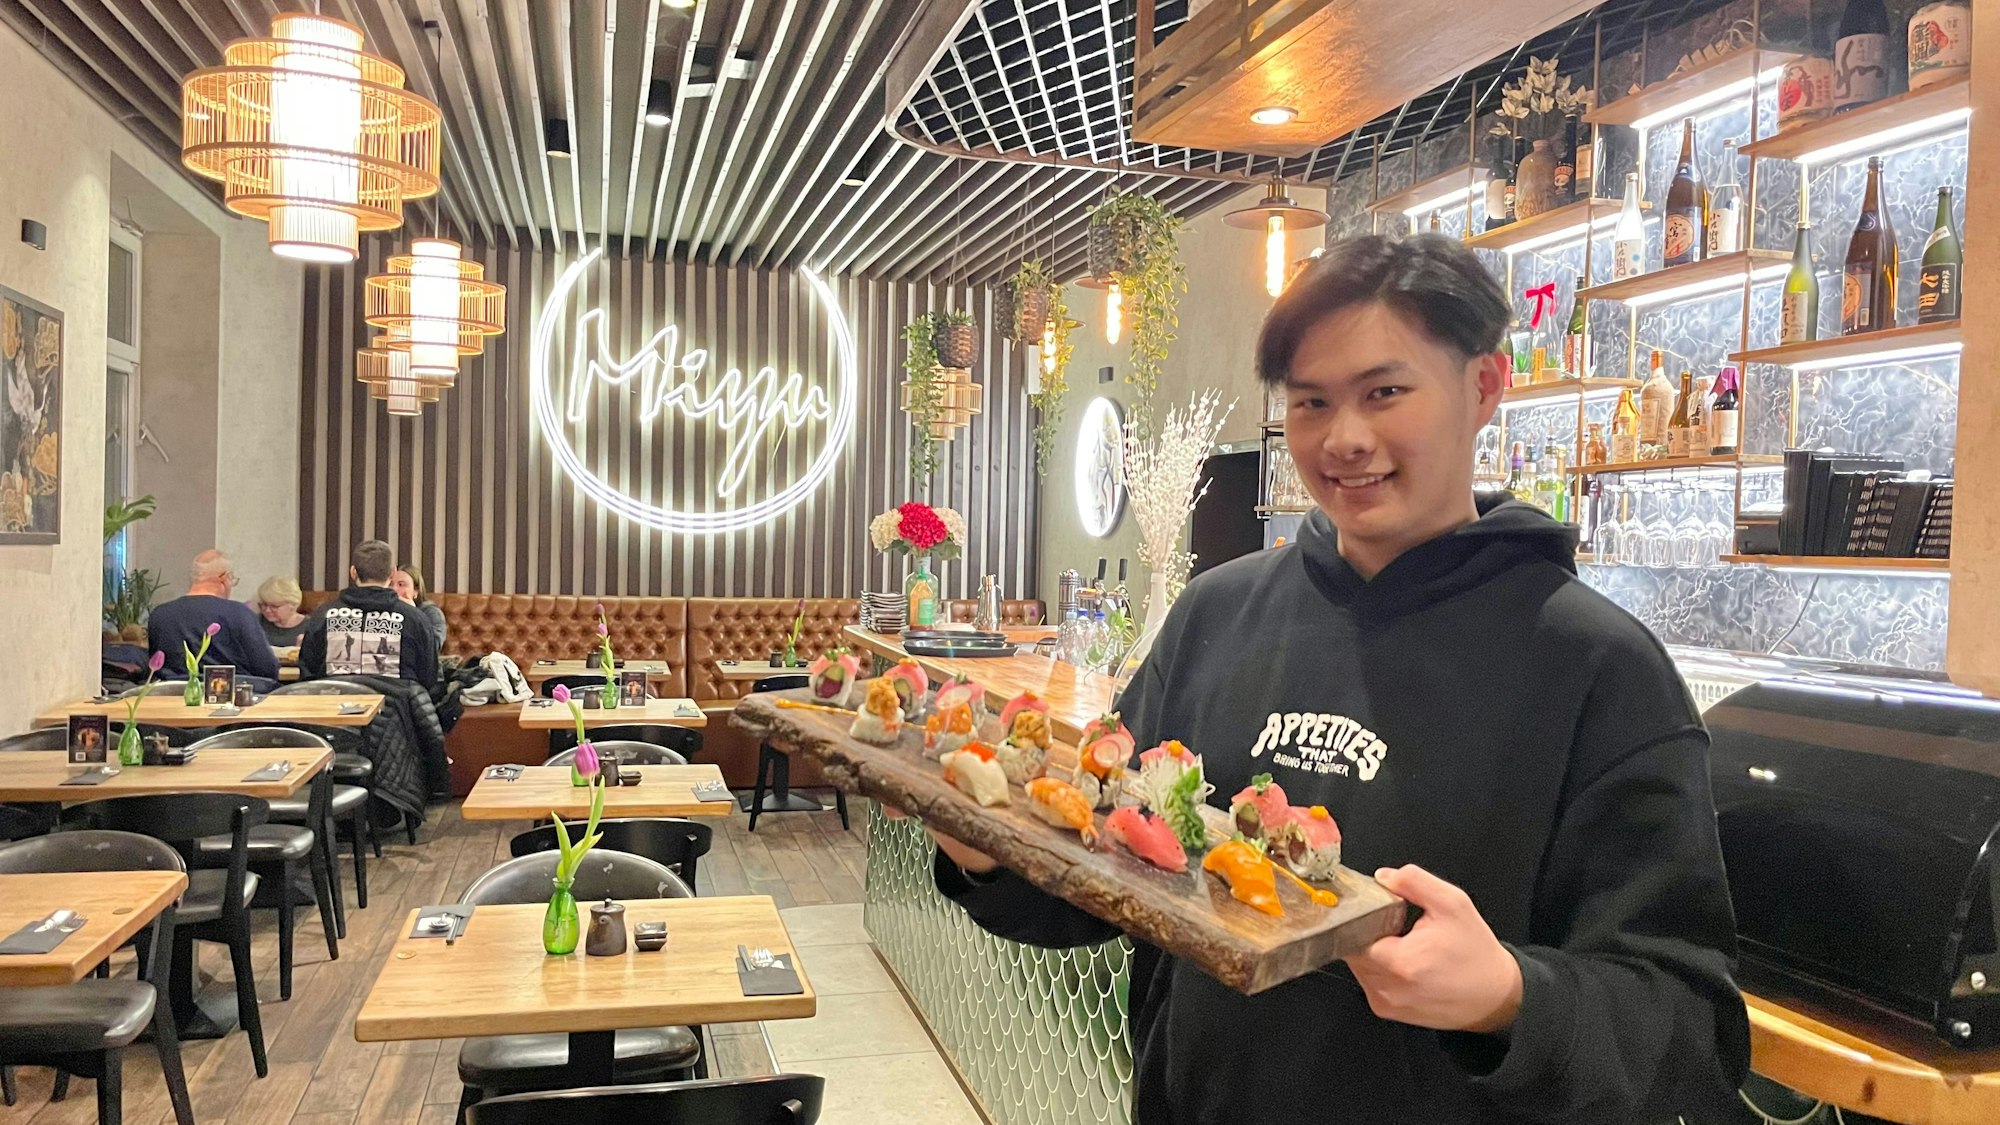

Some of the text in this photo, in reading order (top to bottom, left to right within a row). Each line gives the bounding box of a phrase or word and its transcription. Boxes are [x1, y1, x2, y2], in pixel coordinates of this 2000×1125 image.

[567, 307, 832, 499] Miyu
[326, 607, 404, 623] DOG DAD
[327, 617, 403, 631] DOG DAD
[1250, 712, 1388, 781] APPETITES
[1298, 746, 1338, 763] THAT
[1273, 752, 1349, 777] BRING US TOGETHER
